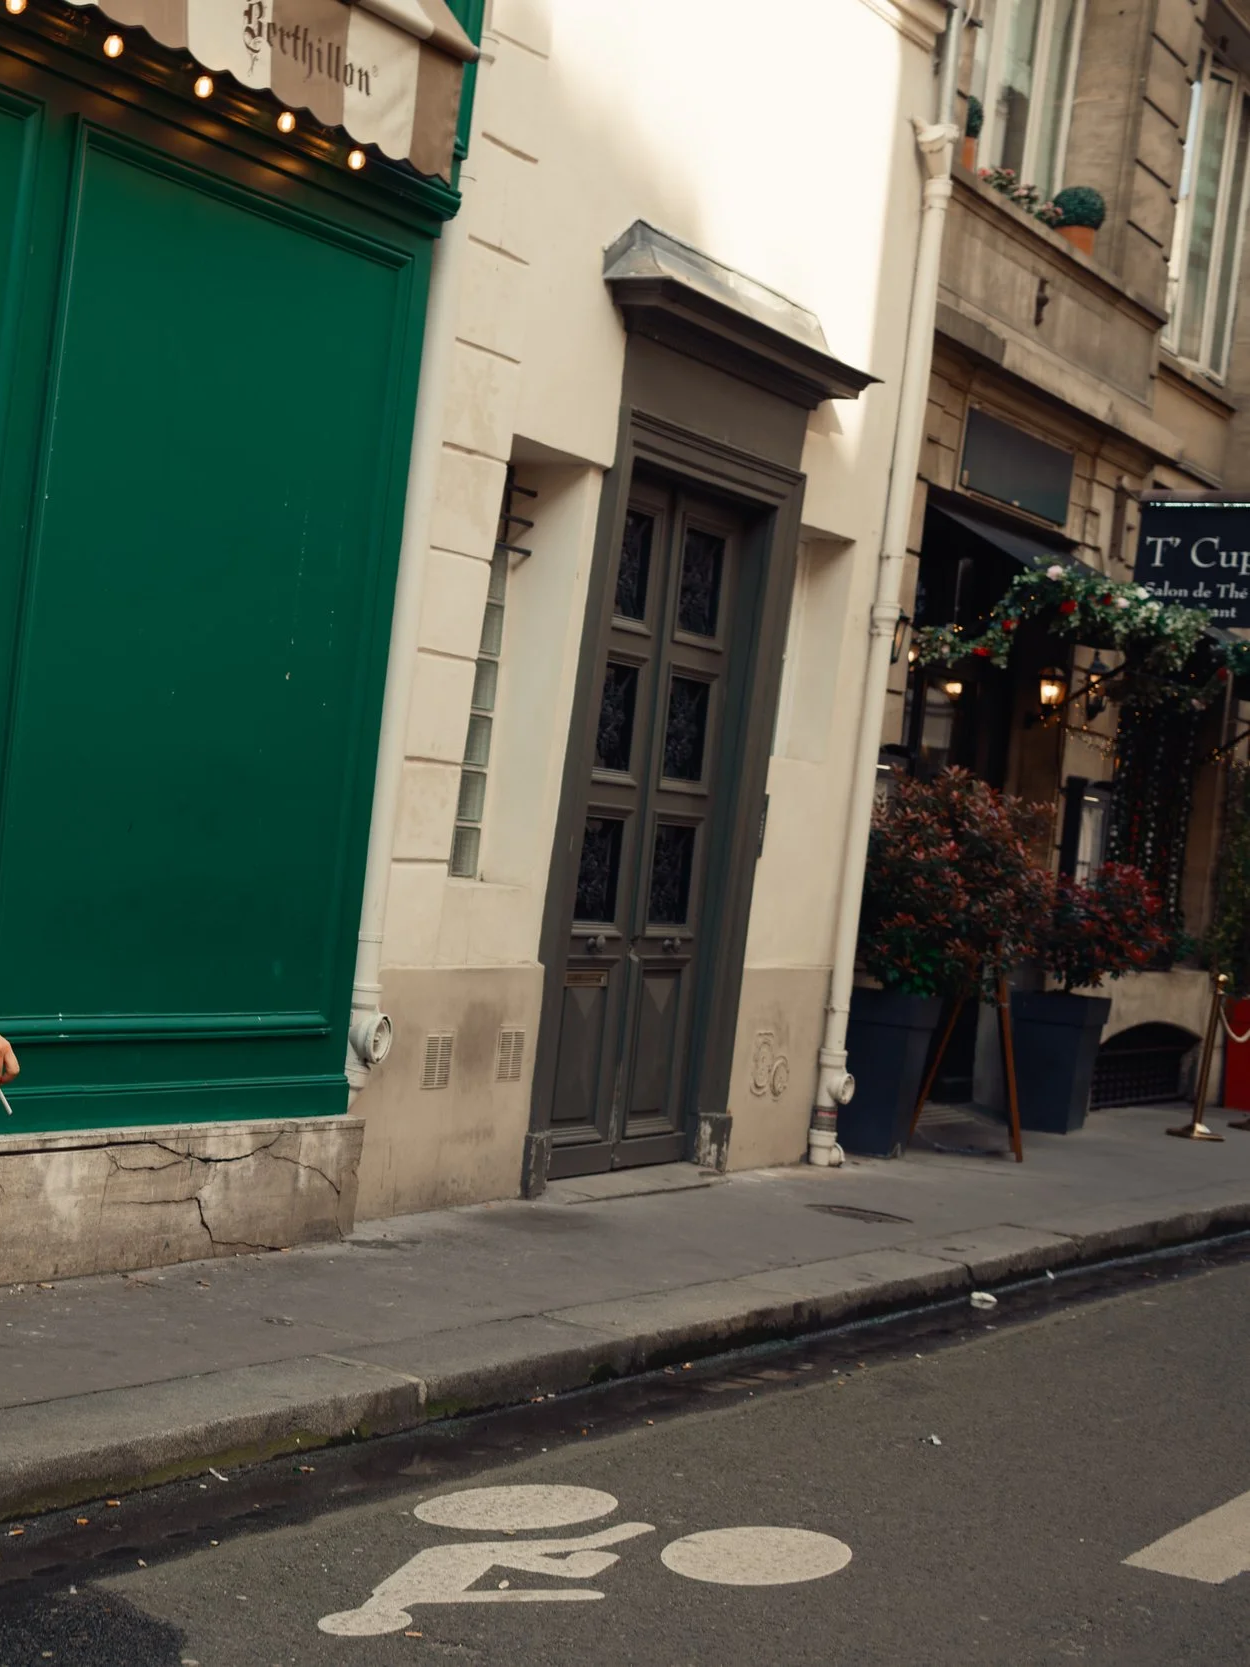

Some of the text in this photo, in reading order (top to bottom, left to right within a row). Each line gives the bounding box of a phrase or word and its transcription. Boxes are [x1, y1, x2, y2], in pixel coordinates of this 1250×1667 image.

[243, 0, 374, 97] Berthillon
[1145, 580, 1248, 600] Salon de Thé
